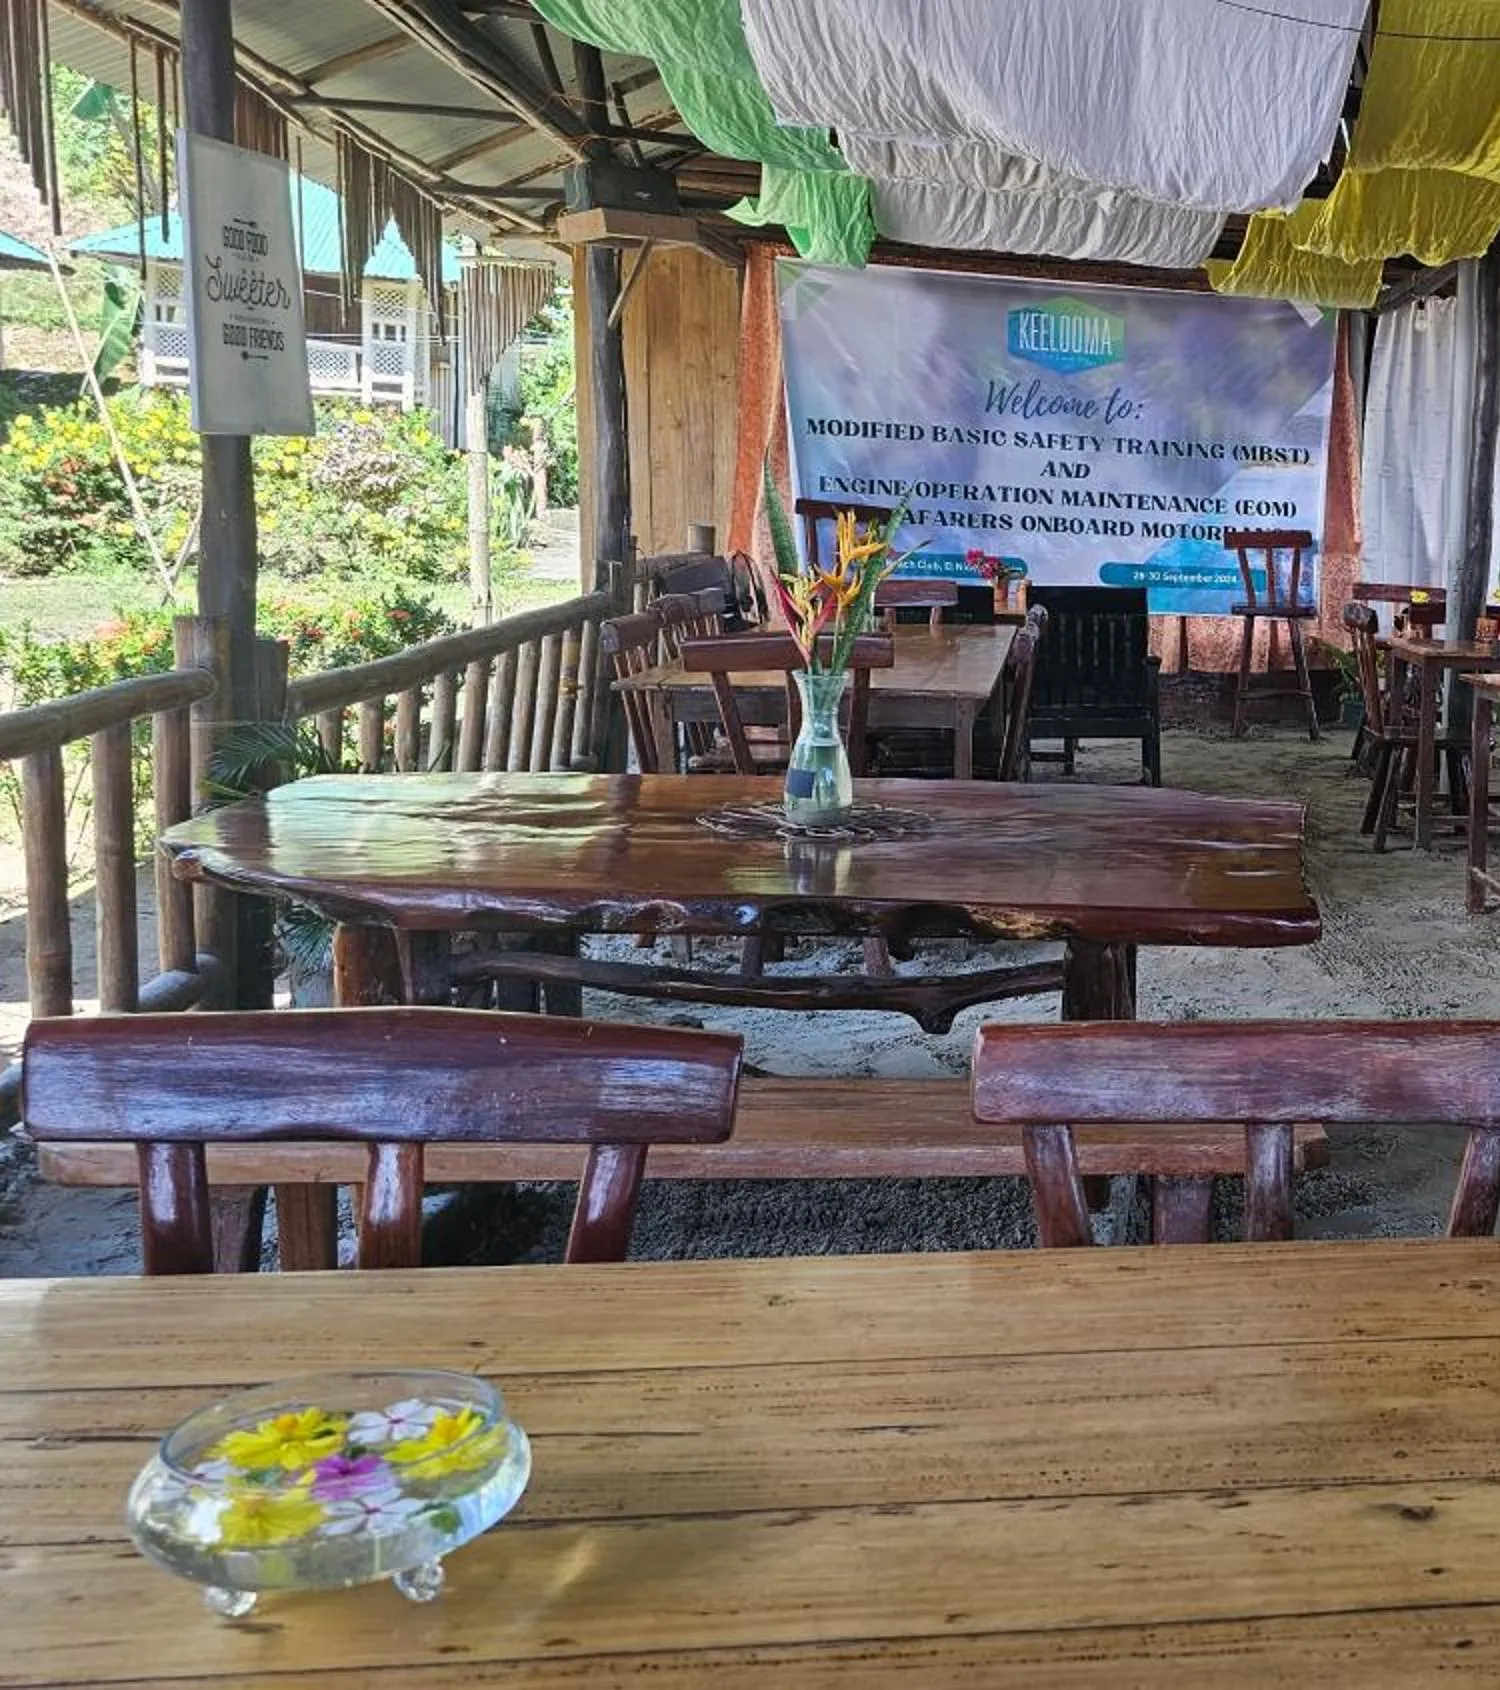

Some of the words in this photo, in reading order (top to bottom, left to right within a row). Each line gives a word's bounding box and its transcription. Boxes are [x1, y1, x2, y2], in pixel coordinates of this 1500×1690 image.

[1018, 311, 1113, 355] KEELOOMA
[984, 379, 1099, 419] Welcome
[1104, 387, 1144, 424] to:
[806, 417, 925, 441] MODIFIED
[932, 425, 1007, 446] BASIC
[1013, 430, 1105, 452] SAFETY
[1112, 437, 1226, 459] TRAINING
[1232, 445, 1311, 465] (MBST)
[1040, 461, 1091, 479] AND
[1061, 490, 1229, 514] MAINTENANCE
[1235, 499, 1297, 518] (EOM)
[899, 508, 1013, 531] AFARERS
[1020, 515, 1135, 538] ONBOARD
